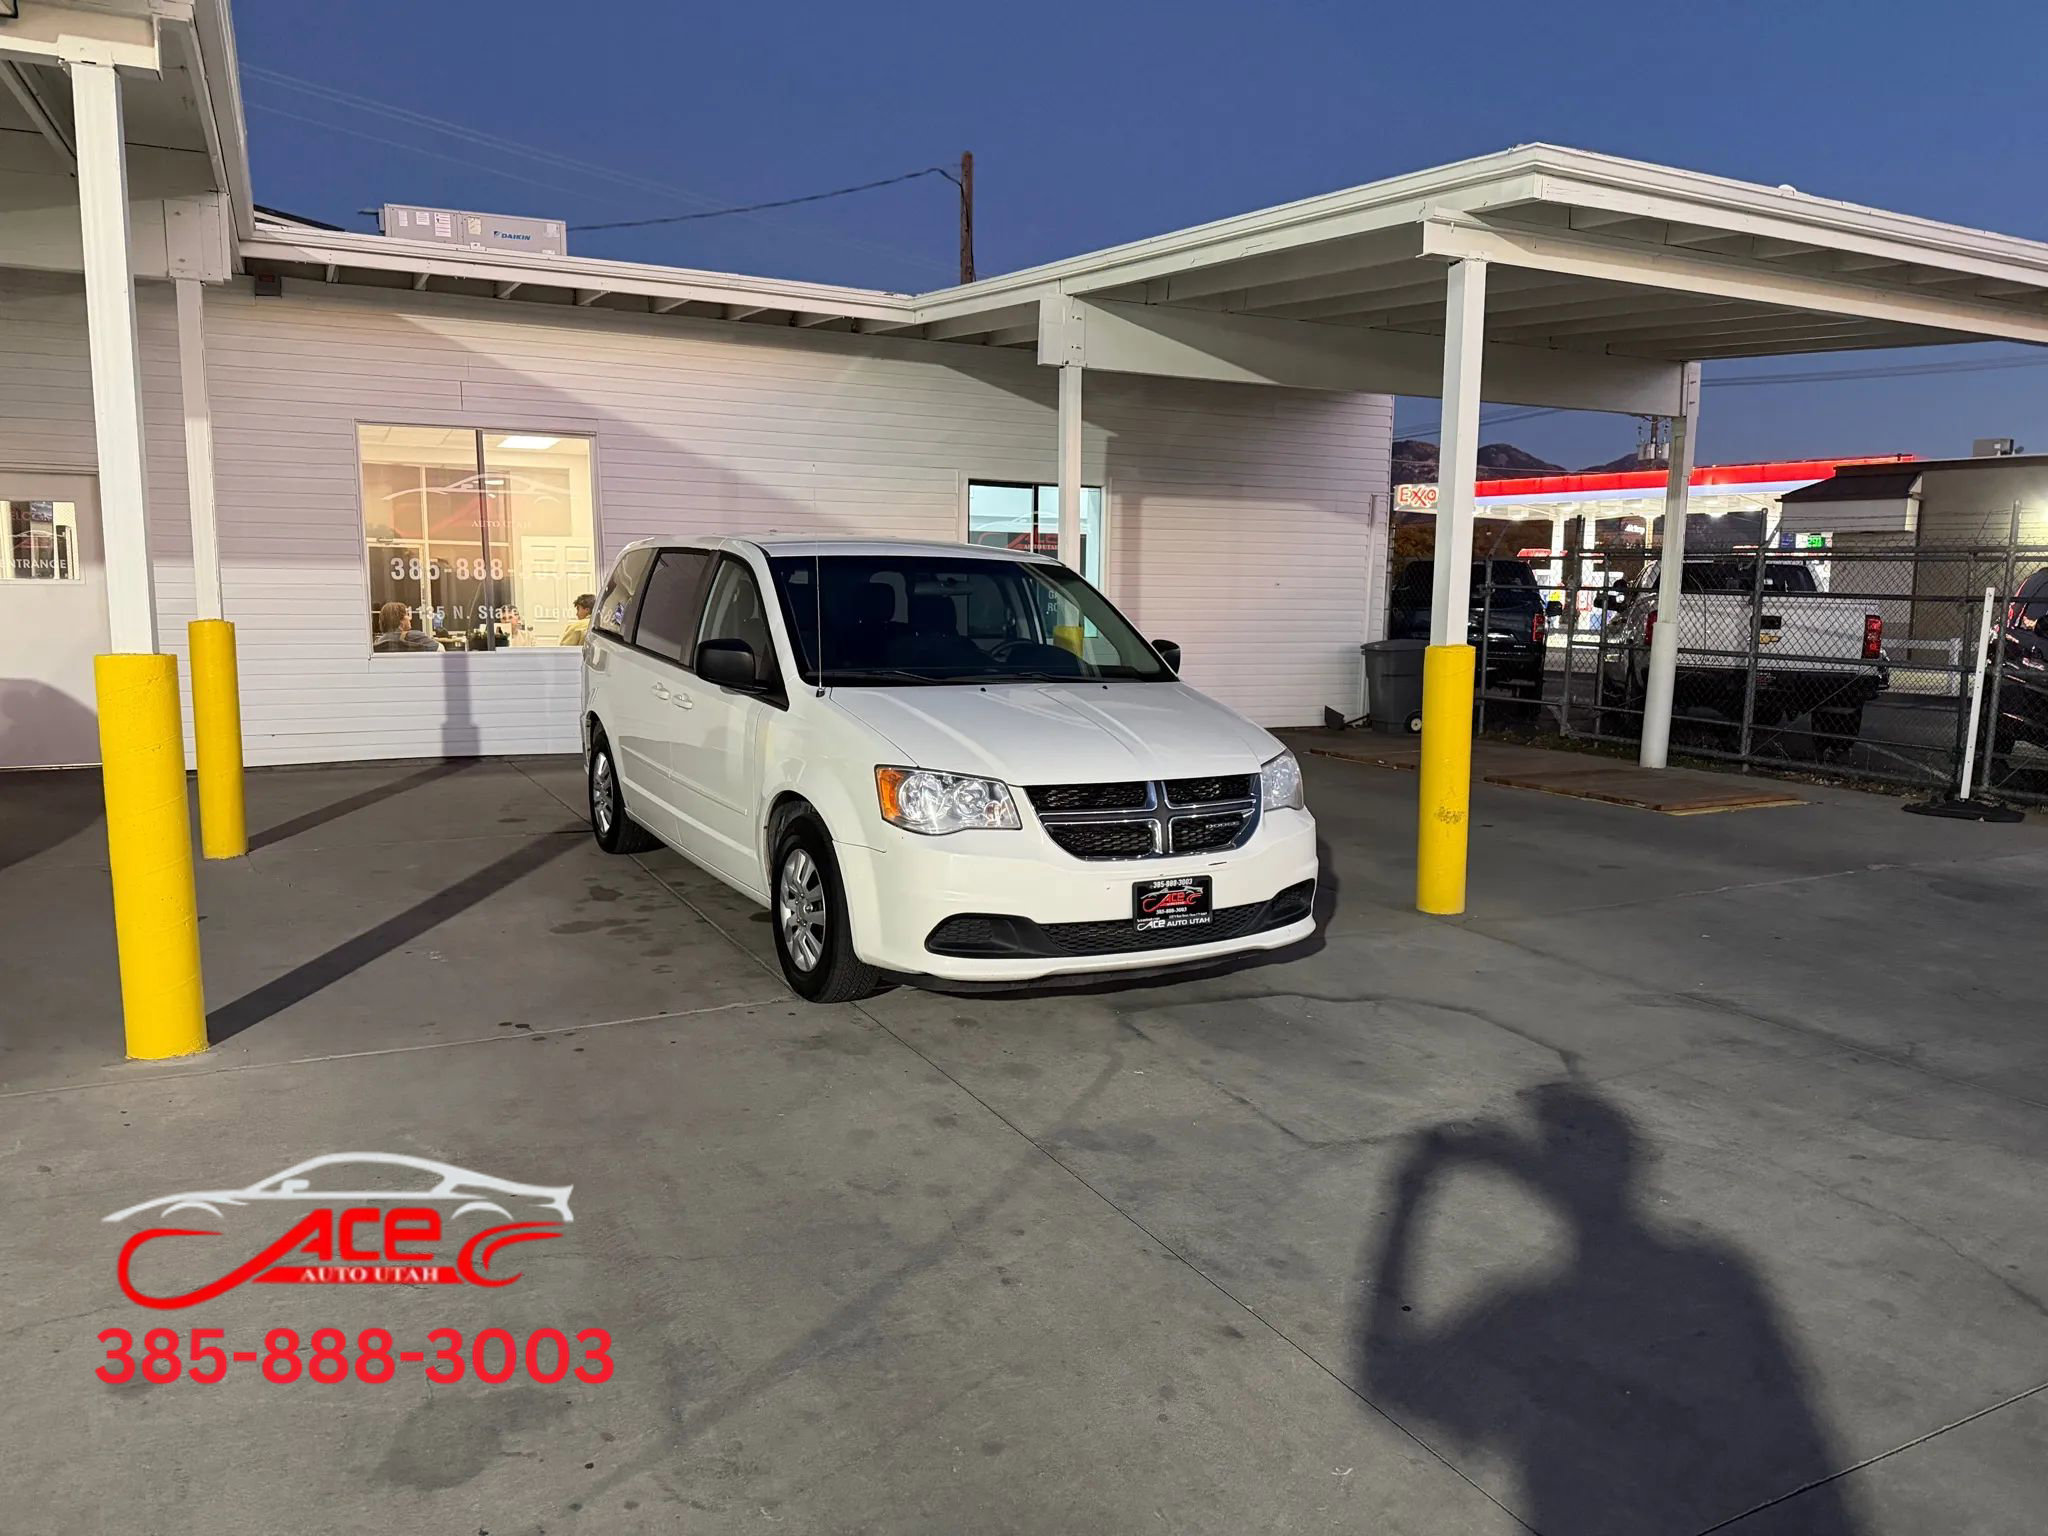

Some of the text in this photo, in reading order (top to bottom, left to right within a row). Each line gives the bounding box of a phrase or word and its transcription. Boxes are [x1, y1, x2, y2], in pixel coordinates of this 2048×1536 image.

[501, 232, 531, 241] DAIKIN
[1399, 485, 1438, 507] EXXO
[453, 605, 471, 620] N.
[478, 604, 518, 620] State
[1189, 917, 1210, 925] UTAH
